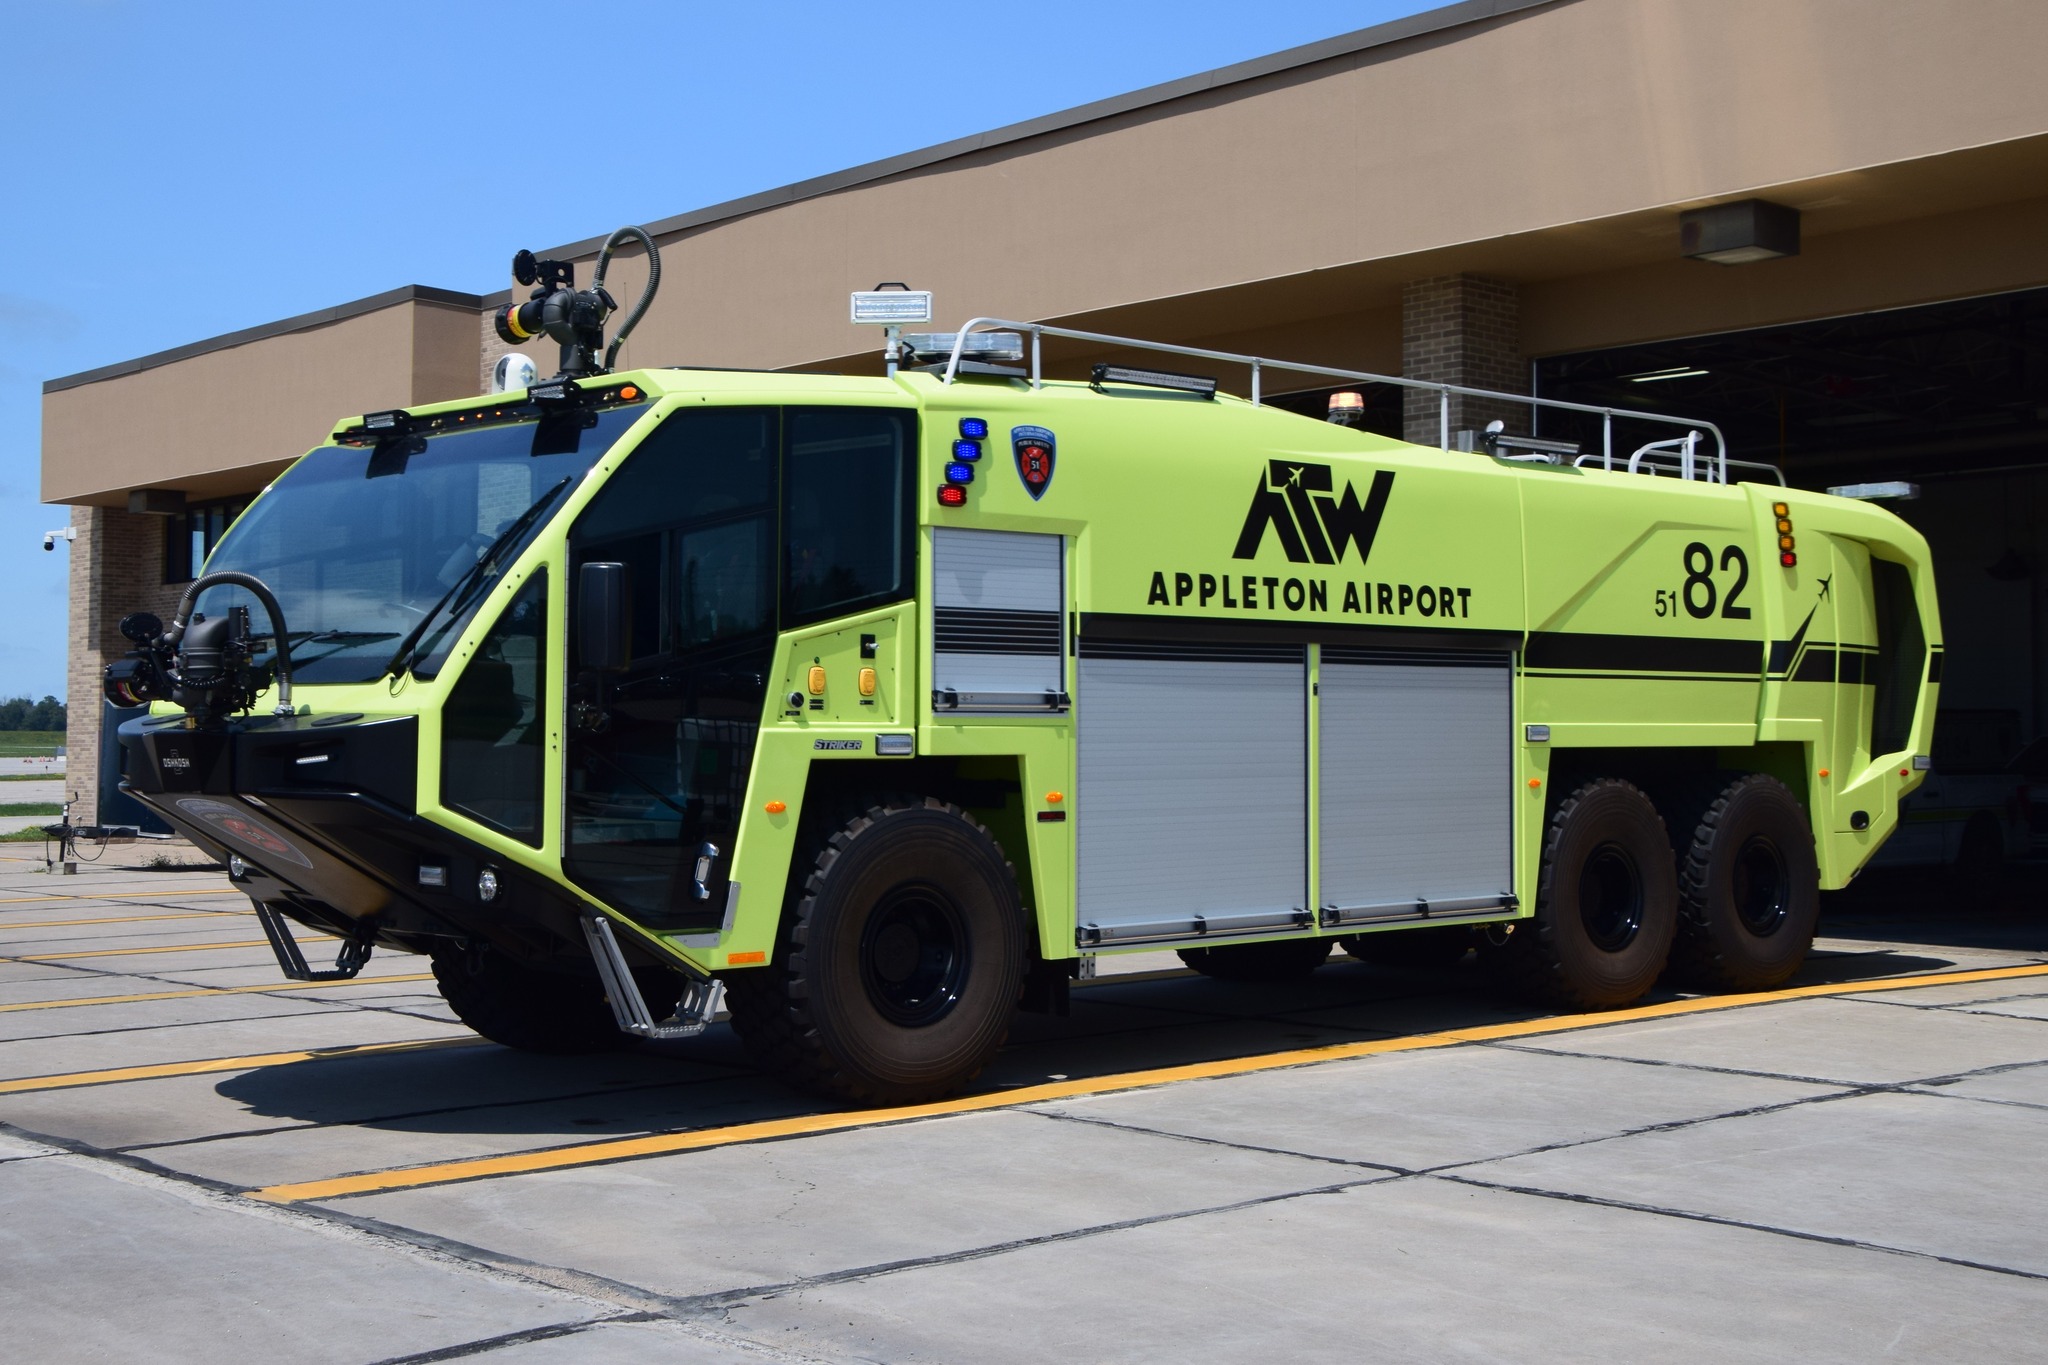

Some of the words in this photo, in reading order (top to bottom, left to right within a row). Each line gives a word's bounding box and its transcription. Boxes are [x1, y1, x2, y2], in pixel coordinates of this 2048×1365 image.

[1031, 460, 1040, 470] 51
[1231, 458, 1397, 566] ATW
[1147, 571, 1328, 612] APPLETON
[1342, 580, 1472, 618] AIRPORT
[814, 739, 862, 750] STRIKER
[163, 758, 190, 767] OSHKOSH
